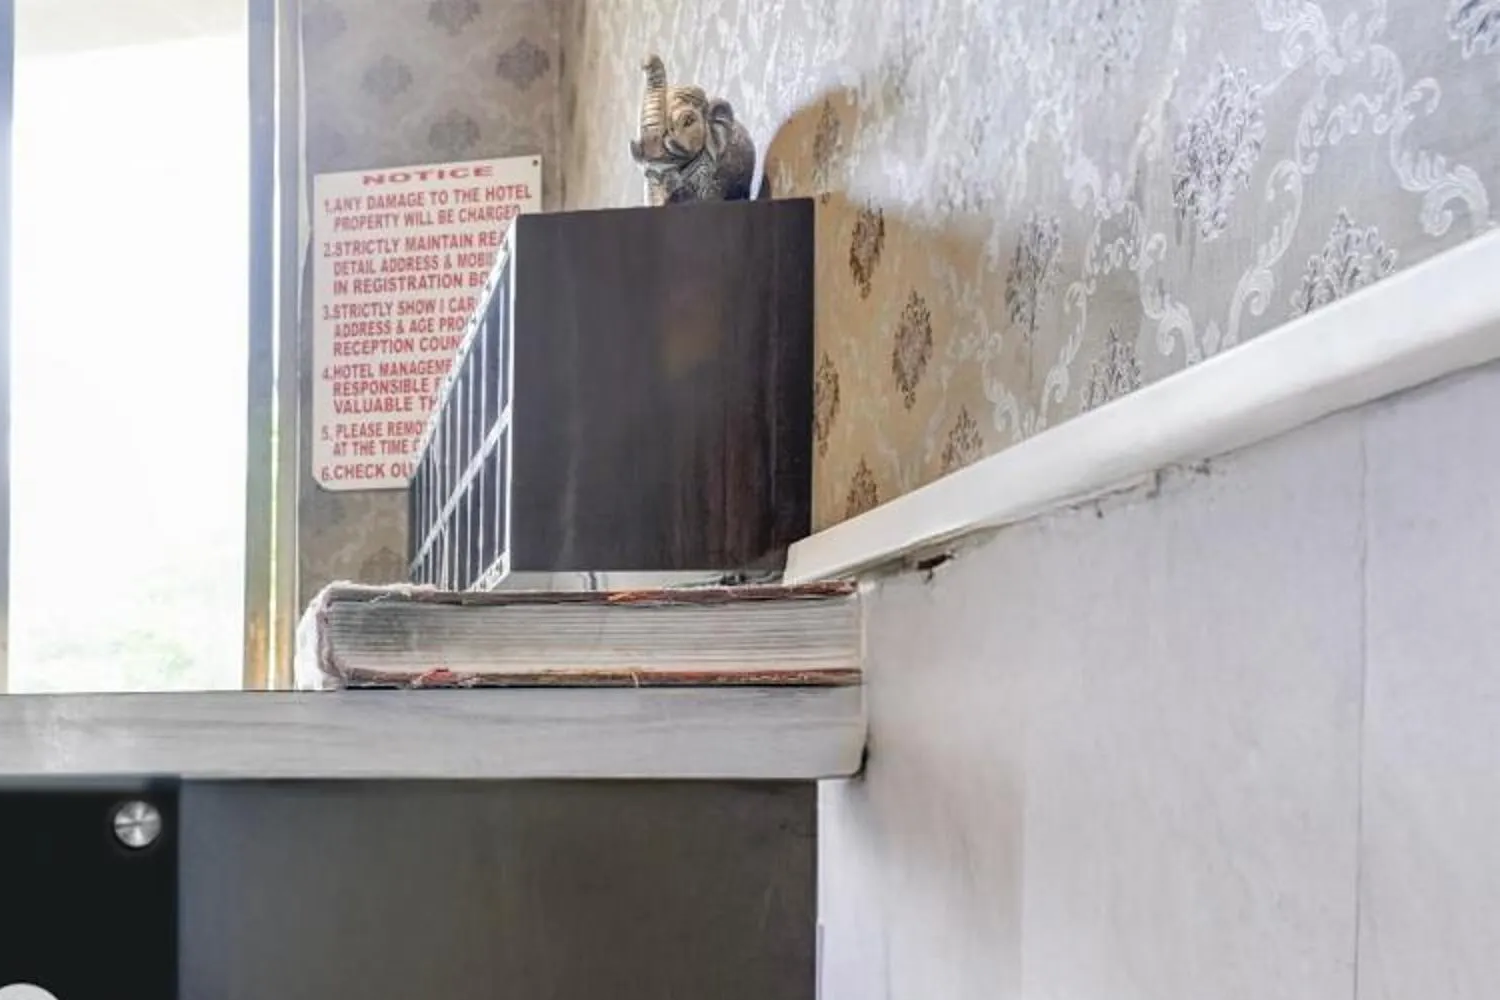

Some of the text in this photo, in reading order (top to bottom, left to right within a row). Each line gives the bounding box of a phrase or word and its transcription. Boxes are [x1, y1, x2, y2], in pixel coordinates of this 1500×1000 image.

[362, 165, 494, 185] NOTICE
[324, 184, 533, 215] 1.ANY DAMAGE TO THE HOTEL
[334, 212, 399, 232] PROPERTY
[404, 210, 434, 227] WILL
[438, 209, 454, 225] BE
[405, 233, 473, 252] MAINTAIN
[334, 257, 376, 276] DETAIL
[381, 254, 439, 273] ADDRESS
[333, 279, 349, 295] IN
[353, 272, 463, 294] REGISTRATION
[399, 298, 435, 316] SHOW
[334, 320, 391, 338] ADDRESS
[409, 317, 435, 333] AGE
[334, 338, 414, 357] RECEPTION
[333, 378, 429, 397] RESPONSIBLE
[334, 396, 413, 414] VALUABLE
[335, 422, 383, 439] PLEASE
[333, 441, 348, 457] AT
[357, 440, 376, 457] THE
[380, 438, 409, 455] TIME
